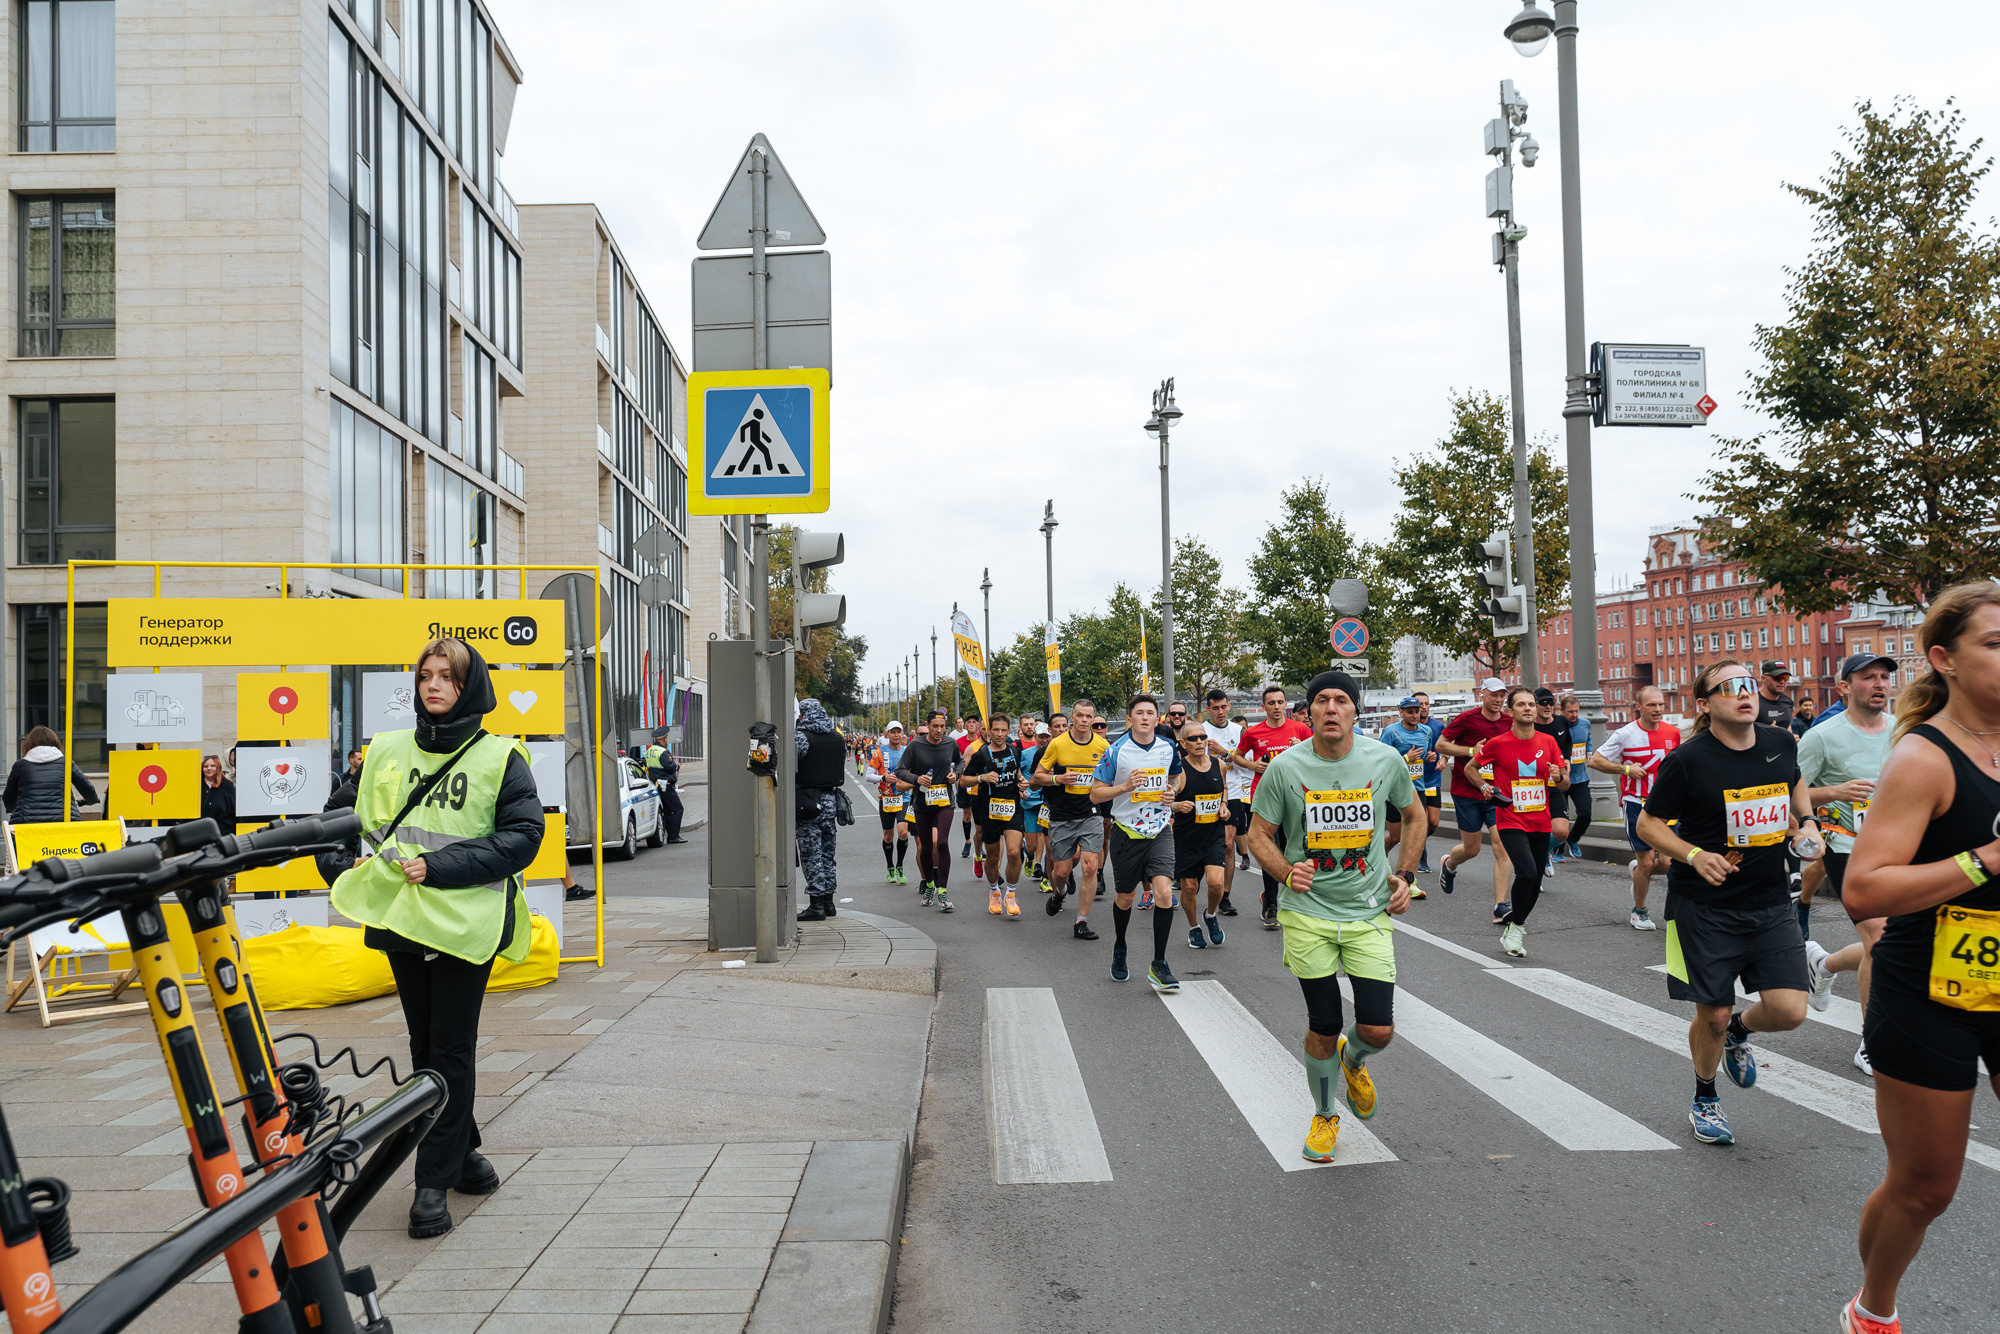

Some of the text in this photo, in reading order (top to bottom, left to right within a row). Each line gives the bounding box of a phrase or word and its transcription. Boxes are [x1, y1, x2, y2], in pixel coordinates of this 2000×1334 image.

[1616, 379, 1677, 387] ПОЛИКЛИНИКА
[1689, 380, 1699, 388] 68
[1632, 391, 1667, 399] ФИЛИАЛ
[139, 616, 224, 630] Генератор
[428, 621, 534, 642] Яндекс Go
[139, 635, 232, 648] поддержки
[926, 789, 948, 798] 15648
[1337, 792, 1354, 801] 42,2
[1355, 791, 1369, 799] KM
[1514, 789, 1544, 801] 18141
[1756, 786, 1773, 797] 42,2
[1774, 786, 1786, 795] KM
[884, 796, 901, 805] 3452
[990, 803, 1015, 813] 17852
[1310, 803, 1371, 824] 10038
[1731, 803, 1787, 828] 18441
[1315, 832, 1323, 843] F
[1738, 834, 1746, 845] E
[41, 844, 97, 856] Яндекс Go
[1947, 979, 1962, 998] D
